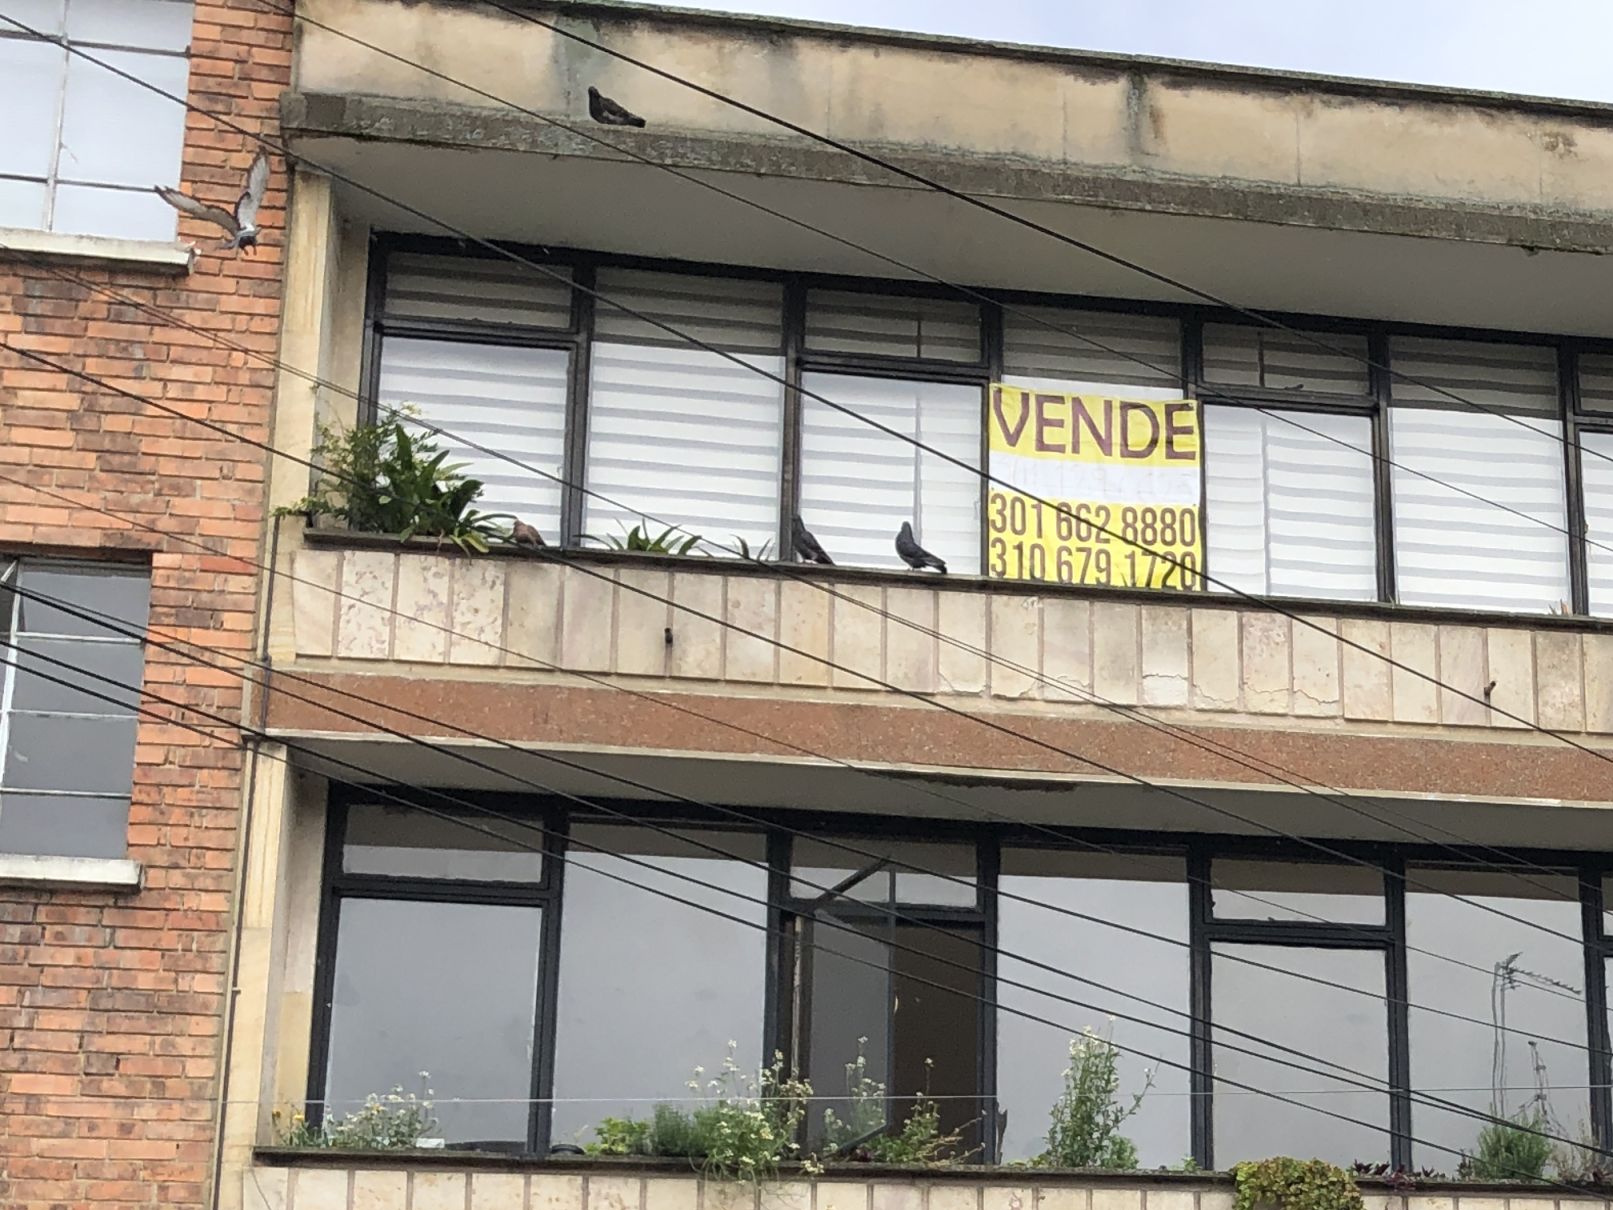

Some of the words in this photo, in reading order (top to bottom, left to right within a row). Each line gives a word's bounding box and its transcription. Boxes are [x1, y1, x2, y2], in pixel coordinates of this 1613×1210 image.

[993, 387, 1197, 461] VENDE
[990, 492, 1043, 539] 301
[1056, 502, 1111, 544] 662
[1121, 506, 1196, 547] 8880
[990, 537, 1046, 582] 310
[1056, 546, 1112, 587] 679
[1123, 550, 1197, 591] 1720
